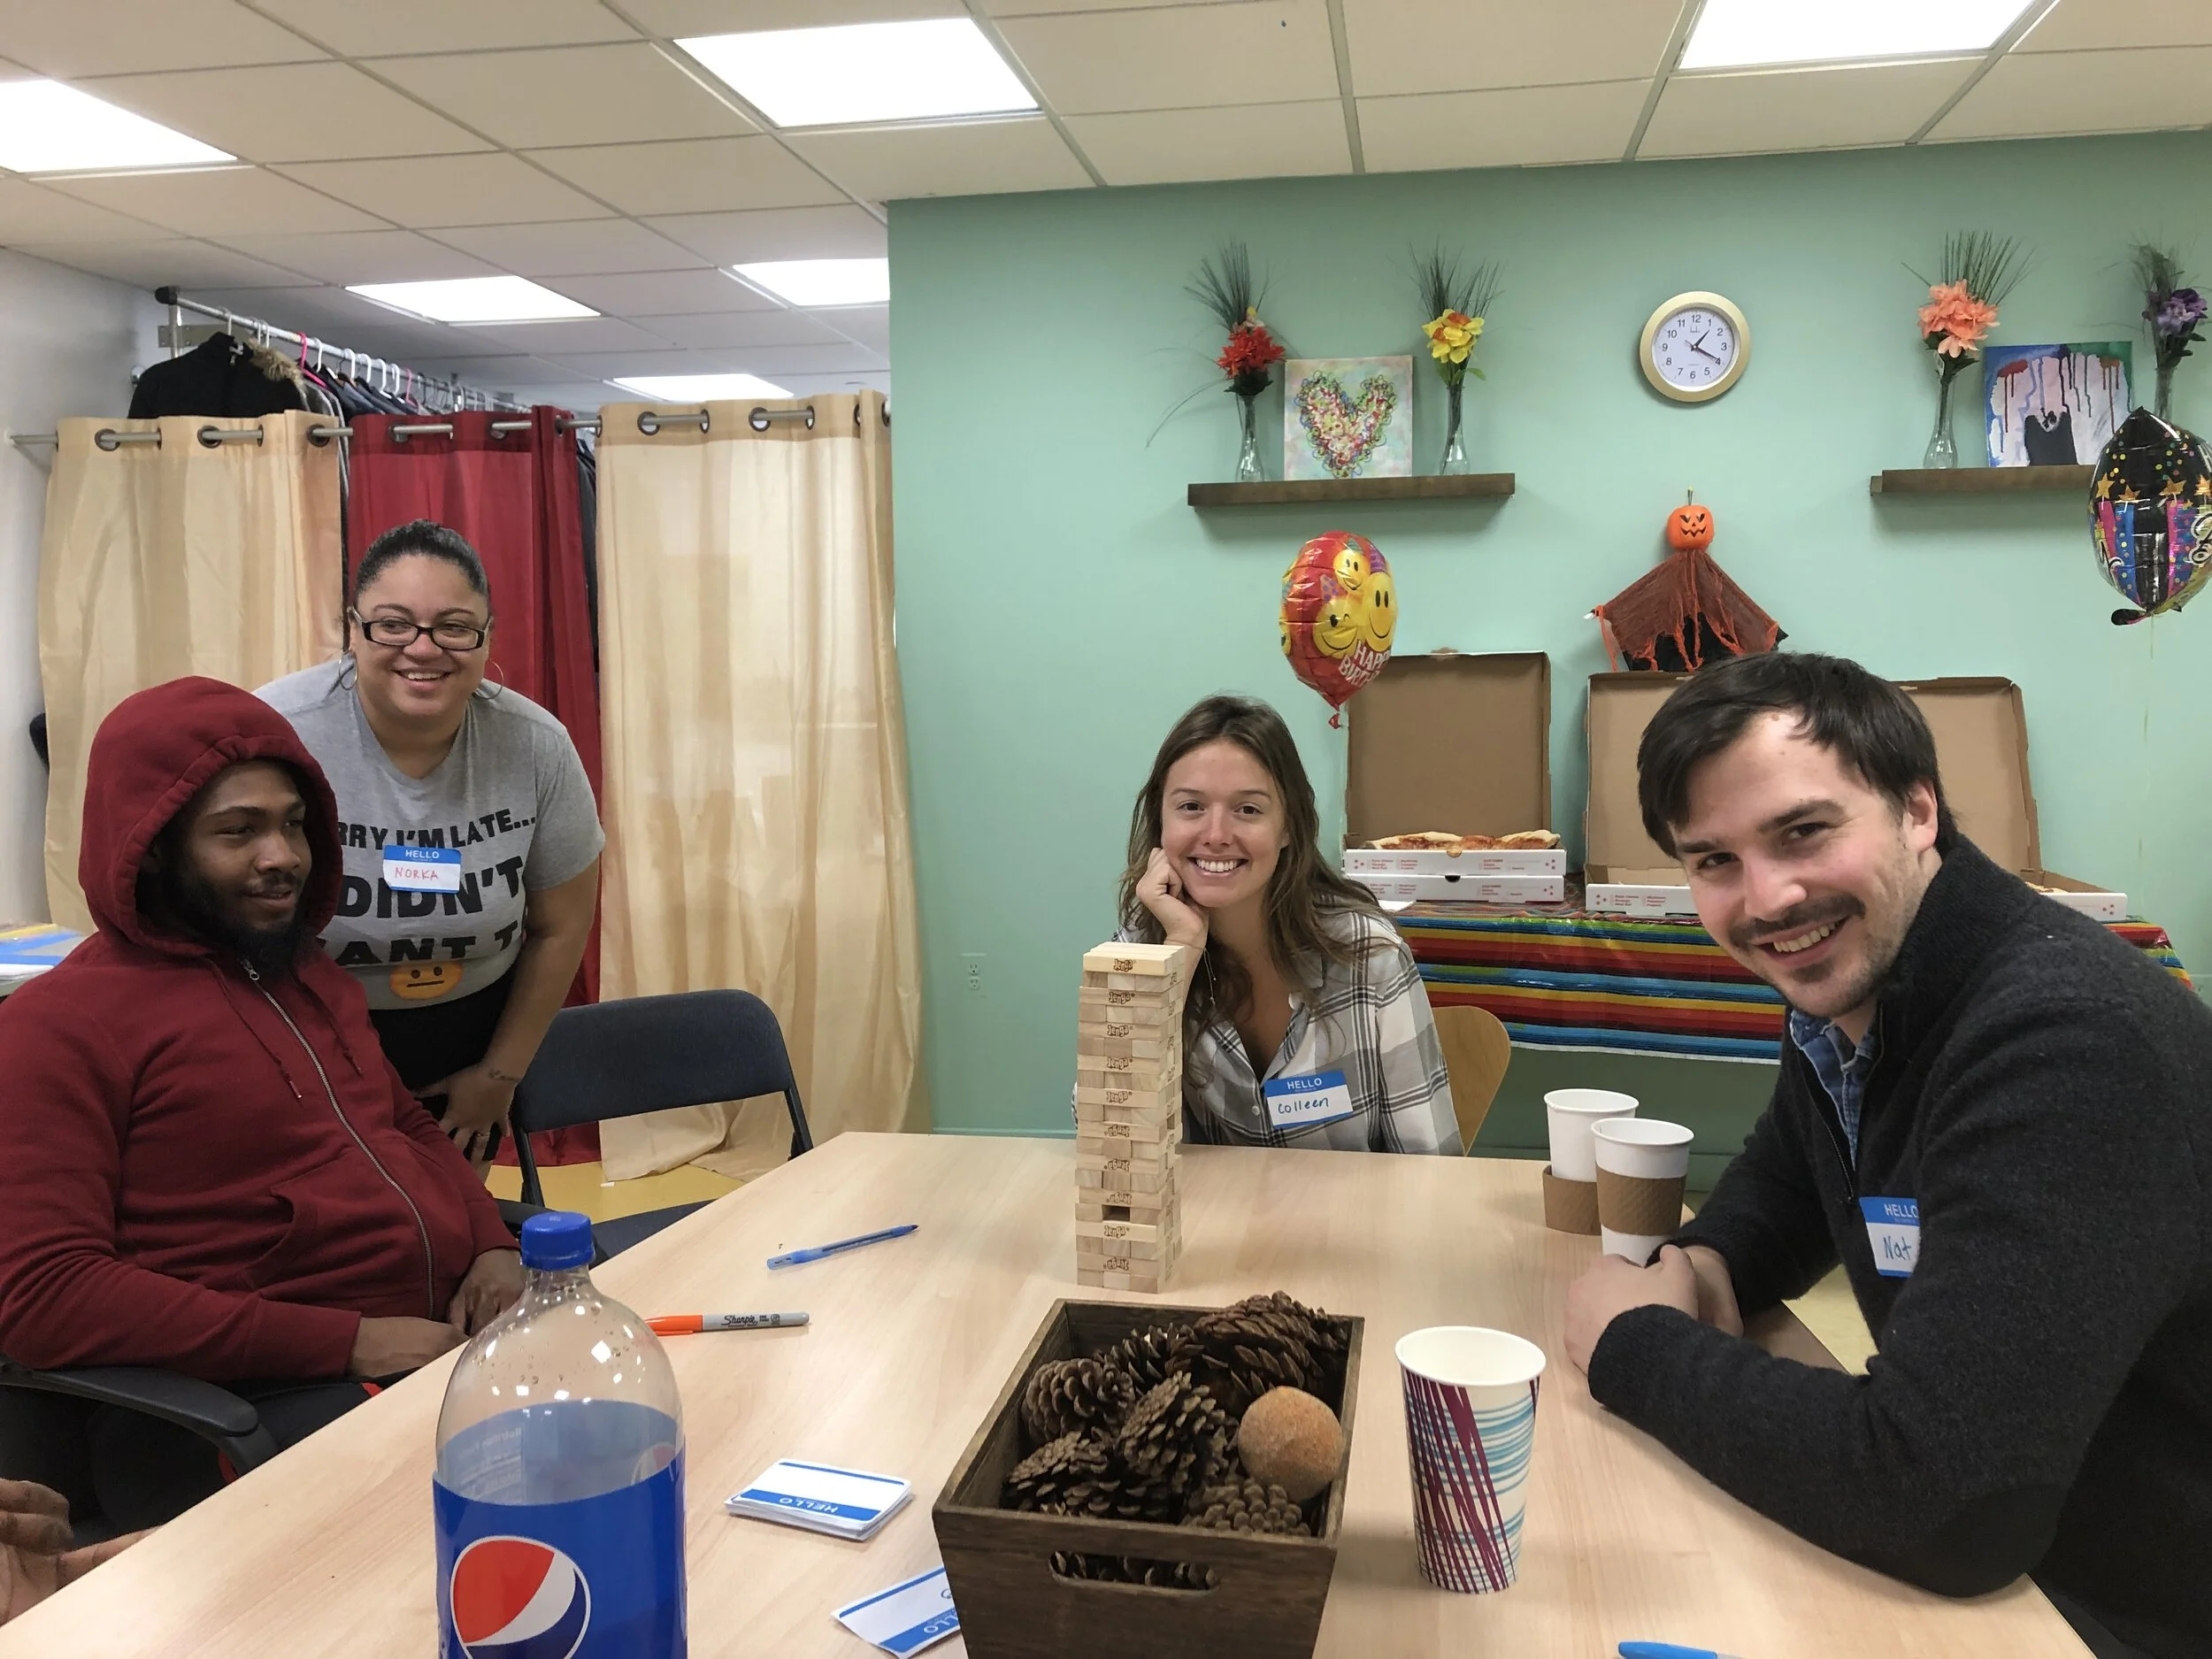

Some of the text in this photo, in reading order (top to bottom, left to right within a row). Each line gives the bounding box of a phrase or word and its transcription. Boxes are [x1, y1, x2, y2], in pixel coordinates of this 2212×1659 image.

[1692, 314, 1701, 323] 12
[1667, 329, 1678, 338] 10
[1717, 327, 1724, 336] 2
[1662, 342, 1669, 352] 9
[1721, 342, 1727, 351] 3
[1665, 357, 1672, 365] 8
[1678, 367, 1684, 376] 7
[1690, 370, 1696, 380] 6
[1704, 366, 1710, 375] 5
[337, 808, 536, 850] RRY I'M LATE...
[405, 849, 440, 859] HELLO
[395, 866, 439, 881] NORKA
[335, 855, 524, 919] DIDN'T
[315, 919, 518, 965] ANT T
[1113, 958, 1133, 972] Jenga
[1109, 991, 1132, 1004] Jenga
[1107, 1025, 1130, 1038] Jenga
[1107, 1057, 1129, 1070] Jenga
[1286, 1078, 1323, 1090] HELLO
[1106, 1091, 1129, 1103] Jenga
[1278, 1097, 1329, 1114] Colleen
[1108, 1124, 1130, 1138] Jenga
[1107, 1158, 1130, 1171] Jenga
[1884, 1203, 1919, 1218] HELLO
[1103, 1225, 1126, 1238] Jenga
[1883, 1234, 1912, 1261] Nat
[1106, 1256, 1129, 1271] Jenga
[720, 1314, 757, 1326] Sharpie
[779, 1497, 839, 1513] HELLO
[923, 1614, 959, 1634] LLO
